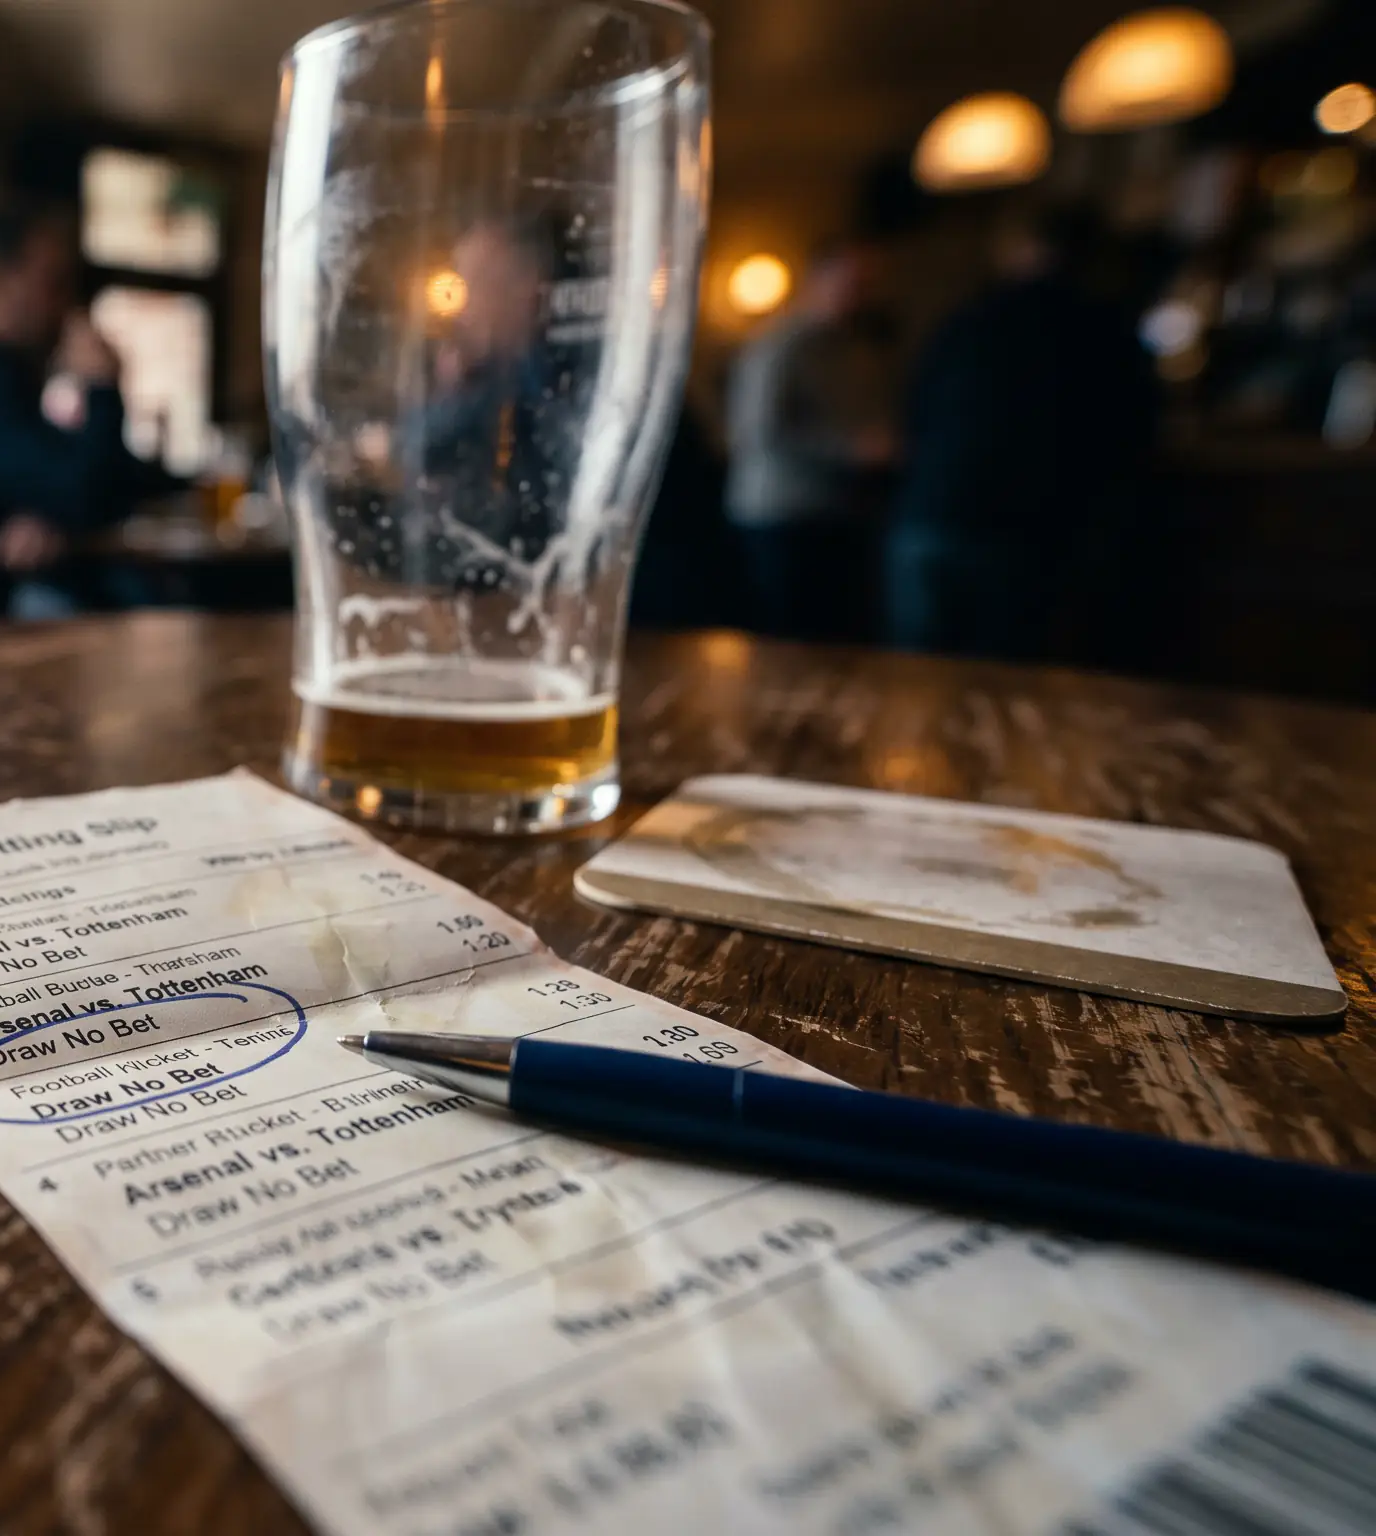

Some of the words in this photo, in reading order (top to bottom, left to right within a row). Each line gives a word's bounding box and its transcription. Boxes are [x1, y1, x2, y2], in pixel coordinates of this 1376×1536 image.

[85, 817, 158, 838] Slip
[15, 931, 55, 950] vs.
[54, 905, 190, 940] Tottenham
[41, 945, 89, 964] Bet
[78, 997, 124, 1016] vs.
[122, 963, 269, 1004] Tottenham
[527, 979, 581, 997] 1.28
[62, 1027, 105, 1049] No
[108, 1013, 161, 1038] Bet
[10, 1065, 114, 1099] Football
[30, 1089, 114, 1120] Draw
[118, 1079, 166, 1098] No
[166, 1061, 225, 1086] Bet
[54, 1111, 139, 1145] Draw
[139, 1100, 188, 1120] No
[189, 1083, 248, 1108] Bet
[123, 1150, 255, 1208] Arsenal
[257, 1141, 312, 1164] vs.
[306, 1092, 477, 1147] Tottenham
[146, 1196, 241, 1241] Draw
[241, 1177, 299, 1206] No
[295, 1157, 362, 1189] Bet
